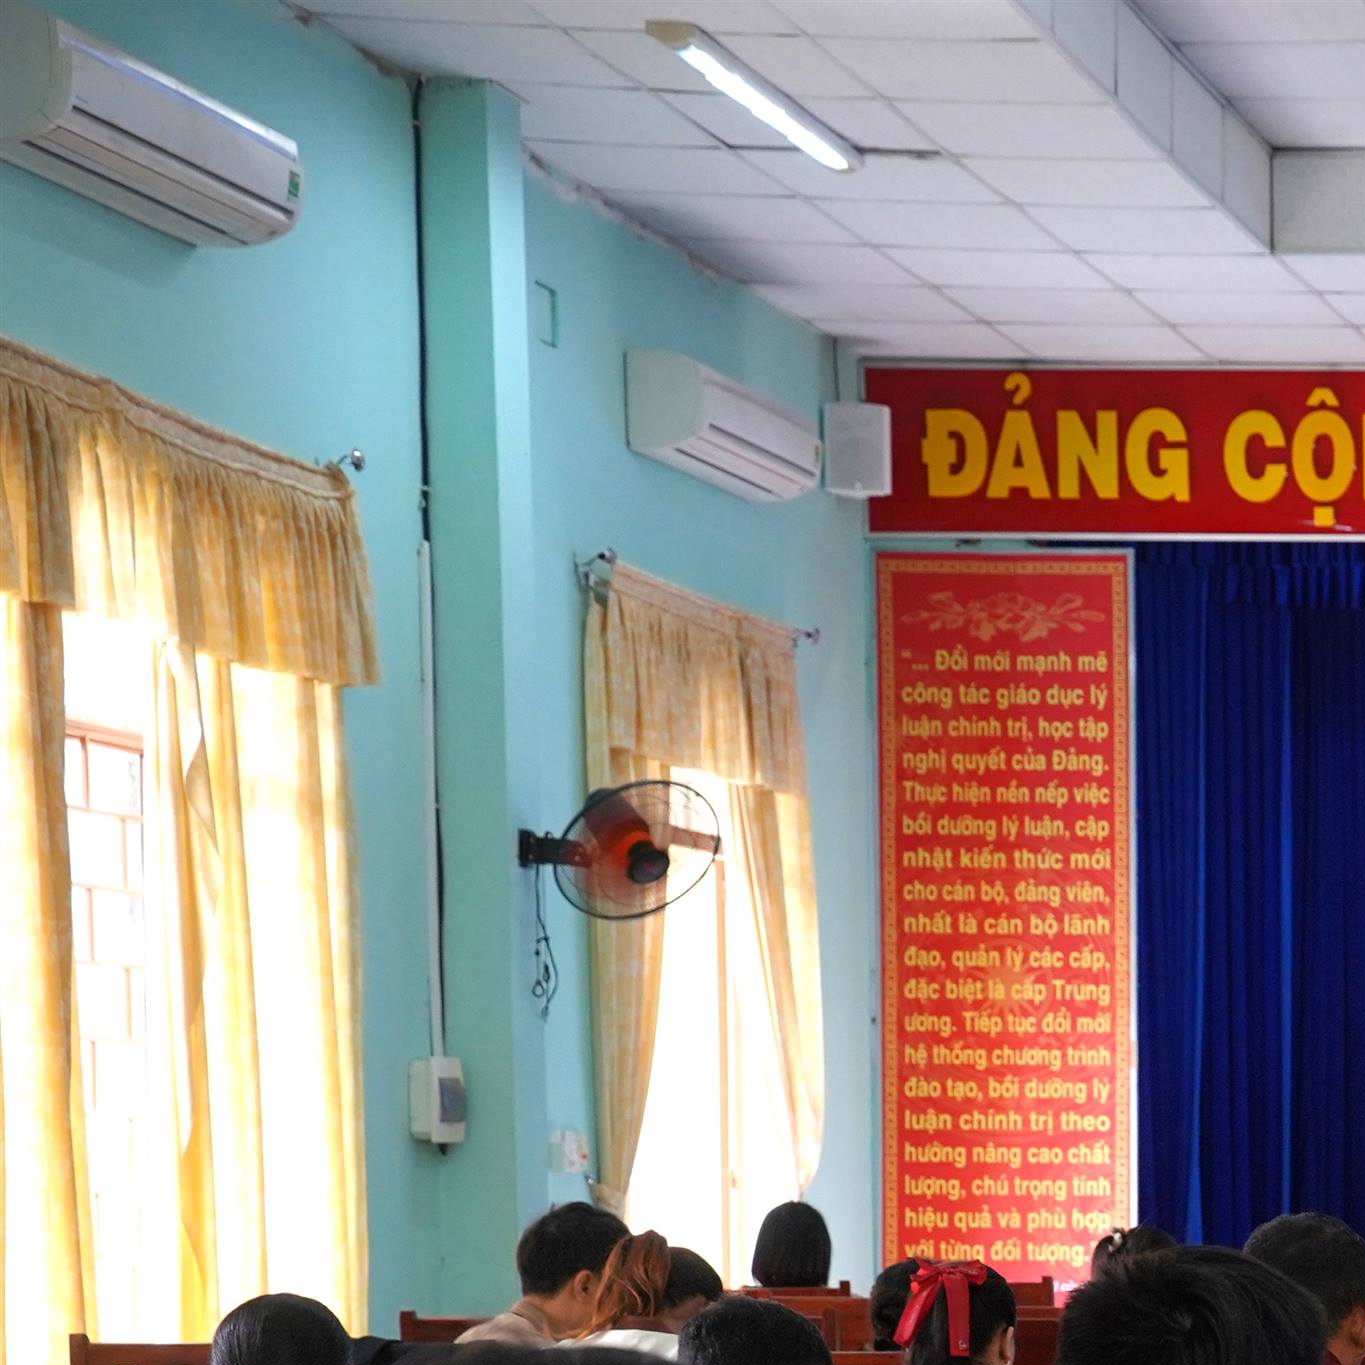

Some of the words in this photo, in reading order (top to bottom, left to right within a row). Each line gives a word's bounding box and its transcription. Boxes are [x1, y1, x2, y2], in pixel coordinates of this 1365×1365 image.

[923, 374, 1190, 501] ĐẢNG
[959, 844, 1007, 869] kiến
[1013, 847, 1063, 870] thức
[1070, 847, 1111, 871] mới
[903, 880, 938, 901] cho
[941, 880, 976, 902] cán
[1065, 880, 1110, 905] viên,
[903, 910, 953, 934] nhất
[958, 913, 978, 934] là
[983, 913, 1023, 935] cán
[1029, 912, 1059, 939] bộ
[1063, 913, 1111, 936] lãnh
[903, 945, 946, 969] đạo,
[951, 943, 1001, 972] quản
[1005, 946, 1024, 973] lý
[1029, 945, 1064, 968] các
[1068, 943, 1111, 973] cấp,
[945, 978, 984, 1004] biệt
[987, 977, 1007, 1002] là
[1010, 974, 1047, 1005] cấp
[1051, 978, 1111, 1007] Trung
[904, 1013, 957, 1038] ương.
[961, 1010, 1003, 1038] Tiếp
[1006, 1013, 1037, 1036] tục
[1041, 1006, 1072, 1034] đổi
[1076, 1011, 1112, 1034] mới
[991, 1045, 1062, 1072] chương
[1066, 1044, 1111, 1067] trình
[903, 1076, 942, 1098] đào
[946, 1078, 983, 1101] tạo,
[1092, 1077, 1111, 1105] lý
[904, 1108, 952, 1134] luận
[958, 1109, 1023, 1131] chính
[1028, 1110, 1054, 1135] trị
[1059, 1110, 1111, 1132] theo
[904, 1141, 967, 1169] hướng
[972, 1141, 1022, 1169] nâng
[1027, 1147, 1064, 1165] cao
[1067, 1139, 1111, 1165] chất
[904, 1174, 966, 1201] lượng,
[971, 1174, 1009, 1196] chú
[1013, 1176, 1068, 1202] trọng
[1071, 1175, 1111, 1197] tính
[904, 1206, 949, 1232] hiệu
[953, 1204, 992, 1233] quả
[997, 1207, 1021, 1229] và
[1027, 1207, 1067, 1233] phù
[1071, 1207, 1113, 1235] hợp
